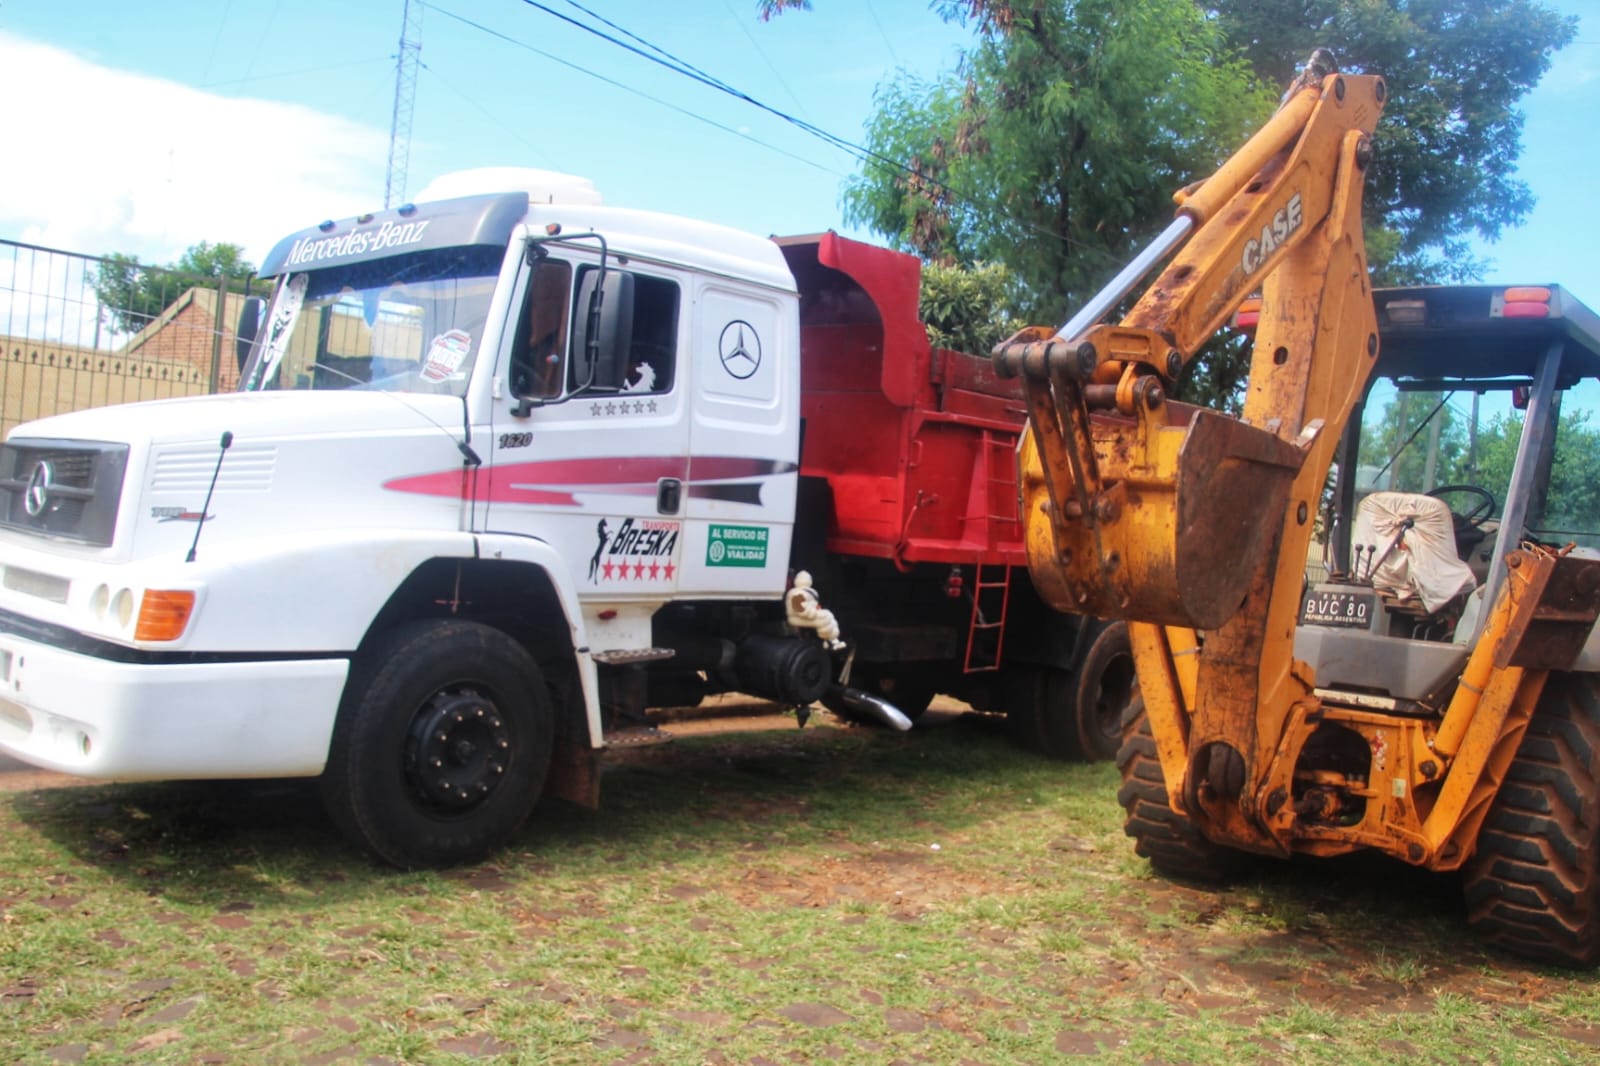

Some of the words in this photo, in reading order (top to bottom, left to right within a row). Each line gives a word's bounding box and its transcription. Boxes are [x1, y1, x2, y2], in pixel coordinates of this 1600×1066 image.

[1242, 191, 1302, 275] CASE
[284, 221, 430, 266] Mercedes-Benz
[499, 432, 534, 449] 1620
[712, 529, 721, 537] AL
[723, 529, 756, 540] SERVICIO
[757, 531, 766, 540] DE
[727, 551, 764, 559] VIALIDAD
[1307, 600, 1339, 614] BVC
[1347, 602, 1366, 617] 80
